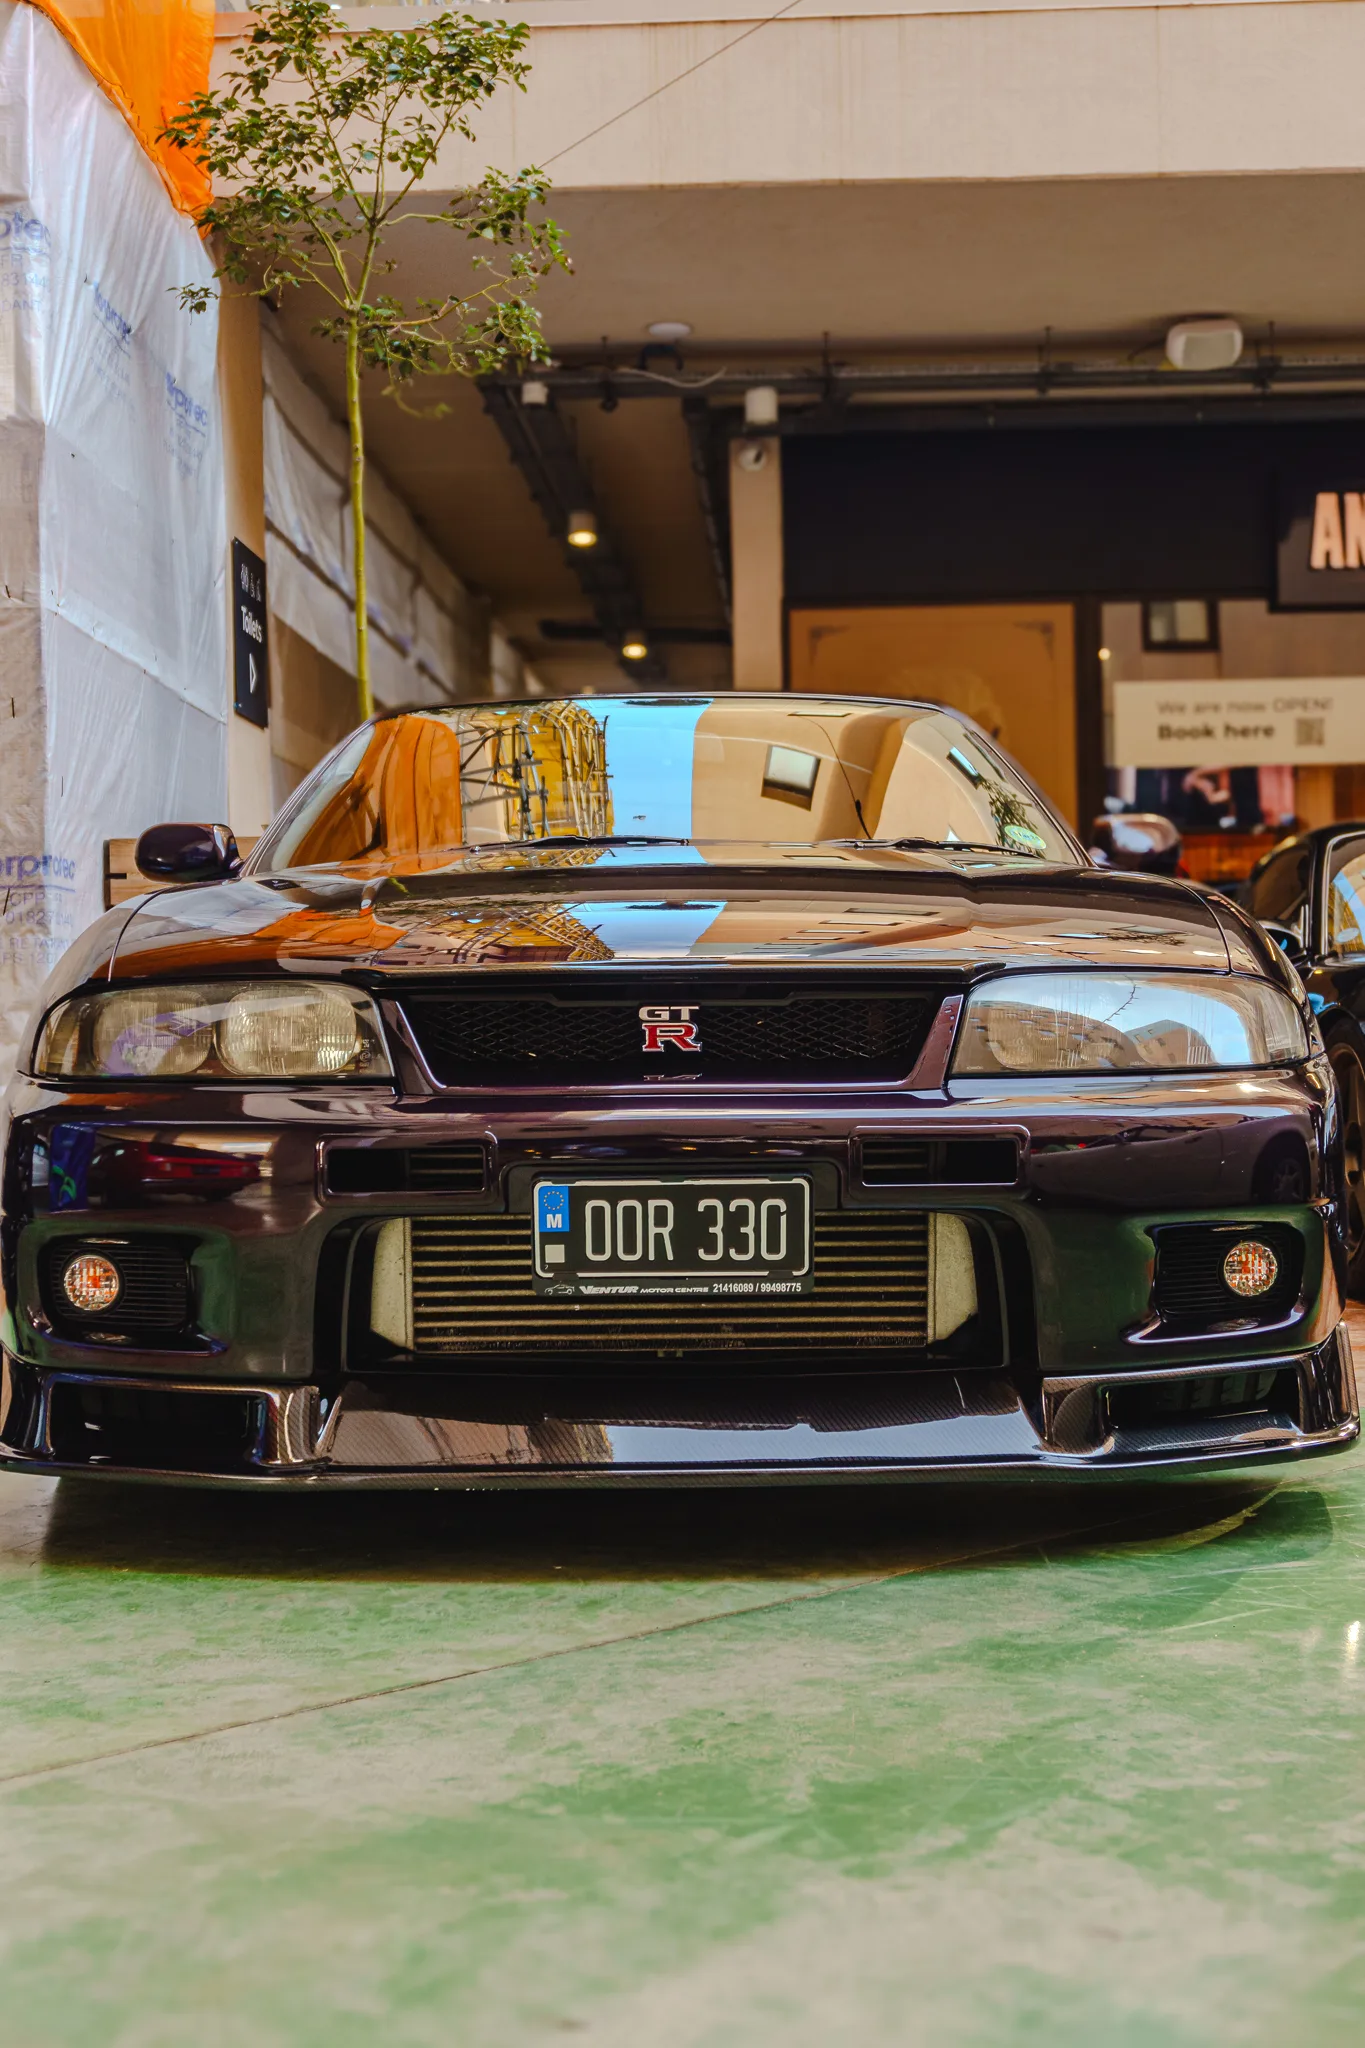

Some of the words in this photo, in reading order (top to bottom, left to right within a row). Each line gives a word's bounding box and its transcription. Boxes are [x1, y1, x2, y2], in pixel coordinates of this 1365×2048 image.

[1310, 492, 1365, 569] AN
[241, 605, 263, 644] Toilets
[1157, 701, 1186, 714] We
[1194, 702, 1221, 714] are
[1227, 701, 1266, 713] now
[1158, 724, 1215, 740] Book
[1224, 722, 1276, 739] here
[638, 1005, 700, 1021] GT
[642, 1022, 703, 1052] R
[546, 1213, 562, 1229] M
[697, 1198, 787, 1261] 330
[579, 1285, 639, 1294] VENTUR
[712, 1282, 754, 1293] 21416089
[760, 1282, 802, 1293] 99498775
